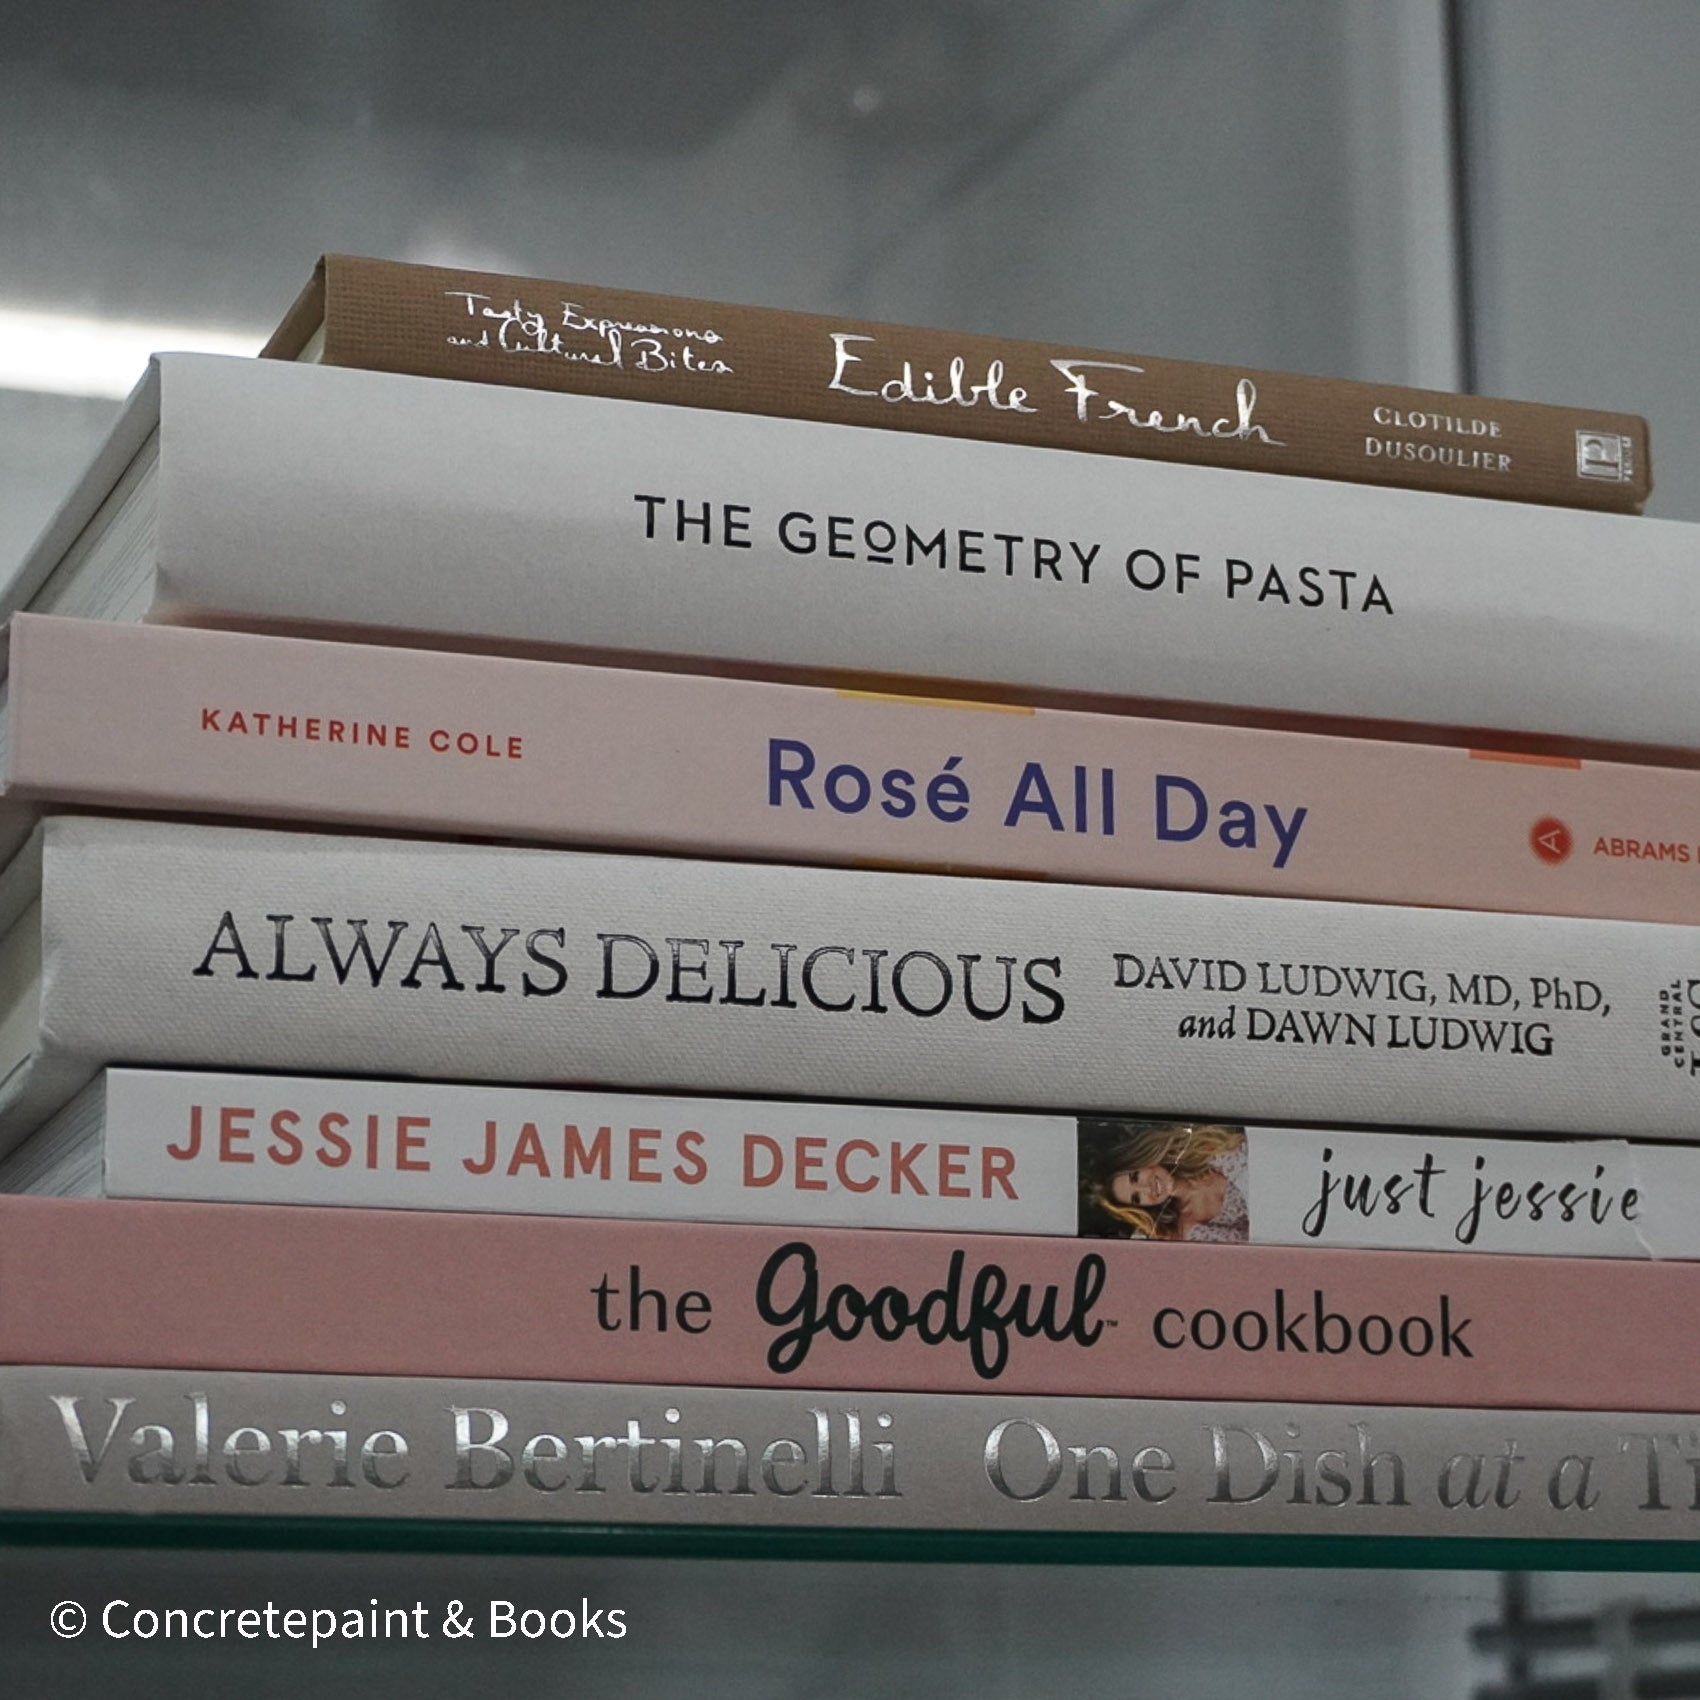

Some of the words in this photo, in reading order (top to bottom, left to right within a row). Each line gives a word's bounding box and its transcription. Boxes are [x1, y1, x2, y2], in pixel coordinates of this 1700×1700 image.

[446, 329, 490, 348] and
[829, 333, 1038, 413] Edible
[1050, 359, 1288, 447] French
[1372, 406, 1503, 438] CLOTILDE
[1364, 436, 1512, 473] DUSOULIER
[634, 494, 752, 549] THE
[779, 511, 1101, 586] GEOMETRY
[1126, 548, 1201, 594] OF
[1225, 559, 1394, 616] PASTA
[202, 709, 410, 749] KATHERINE
[430, 730, 523, 759] COLE
[767, 738, 971, 823] Rosé
[1004, 762, 1115, 836] All
[1155, 775, 1308, 869] Day
[1593, 835, 1691, 863] ABRAMS
[193, 910, 568, 997] ALWAYS
[597, 932, 1067, 1025] DELICIOUS
[1113, 953, 1246, 992] DAVID
[1257, 962, 1437, 1005] LUDWIG,
[1448, 973, 1520, 1012] MD,
[1530, 977, 1611, 1018] PhD,
[1178, 1006, 1236, 1039] and
[1246, 1008, 1377, 1047] DAWN
[1387, 1014, 1554, 1057] LUDWIG
[1659, 989, 1671, 1057] GRAND
[1671, 979, 1685, 1069] CENTRAL
[166, 1105, 431, 1172] JESSIE
[462, 1121, 708, 1185] JAMES
[743, 1134, 1019, 1200] DECKER
[1302, 1147, 1446, 1237] just
[1454, 1155, 1640, 1245] jessie
[591, 1263, 713, 1335] the
[1152, 1288, 1474, 1358] cookbook
[49, 1391, 410, 1490] Valerie
[445, 1405, 903, 1501] Bertinelli
[984, 1417, 1178, 1503] One
[1204, 1422, 1411, 1508] Dish
[1436, 1437, 1524, 1511] at
[1546, 1453, 1600, 1511] a
